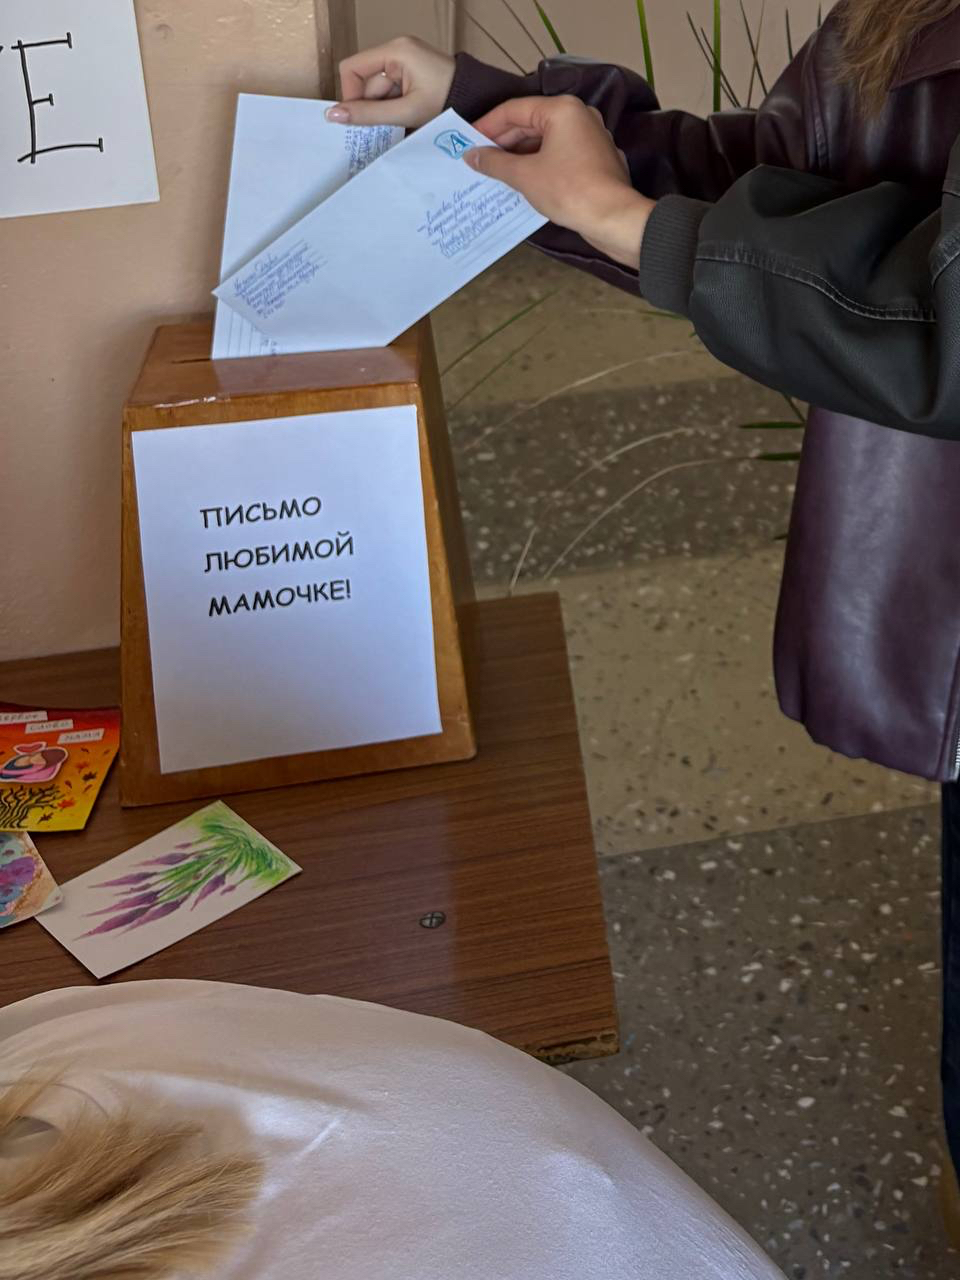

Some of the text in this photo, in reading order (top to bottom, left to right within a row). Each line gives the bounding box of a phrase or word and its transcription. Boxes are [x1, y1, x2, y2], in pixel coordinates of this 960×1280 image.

[199, 496, 322, 528] ПИСЬМО
[203, 531, 354, 573] ЛЮБИМОЙ
[208, 578, 351, 617] МАМОЧКЕ!
